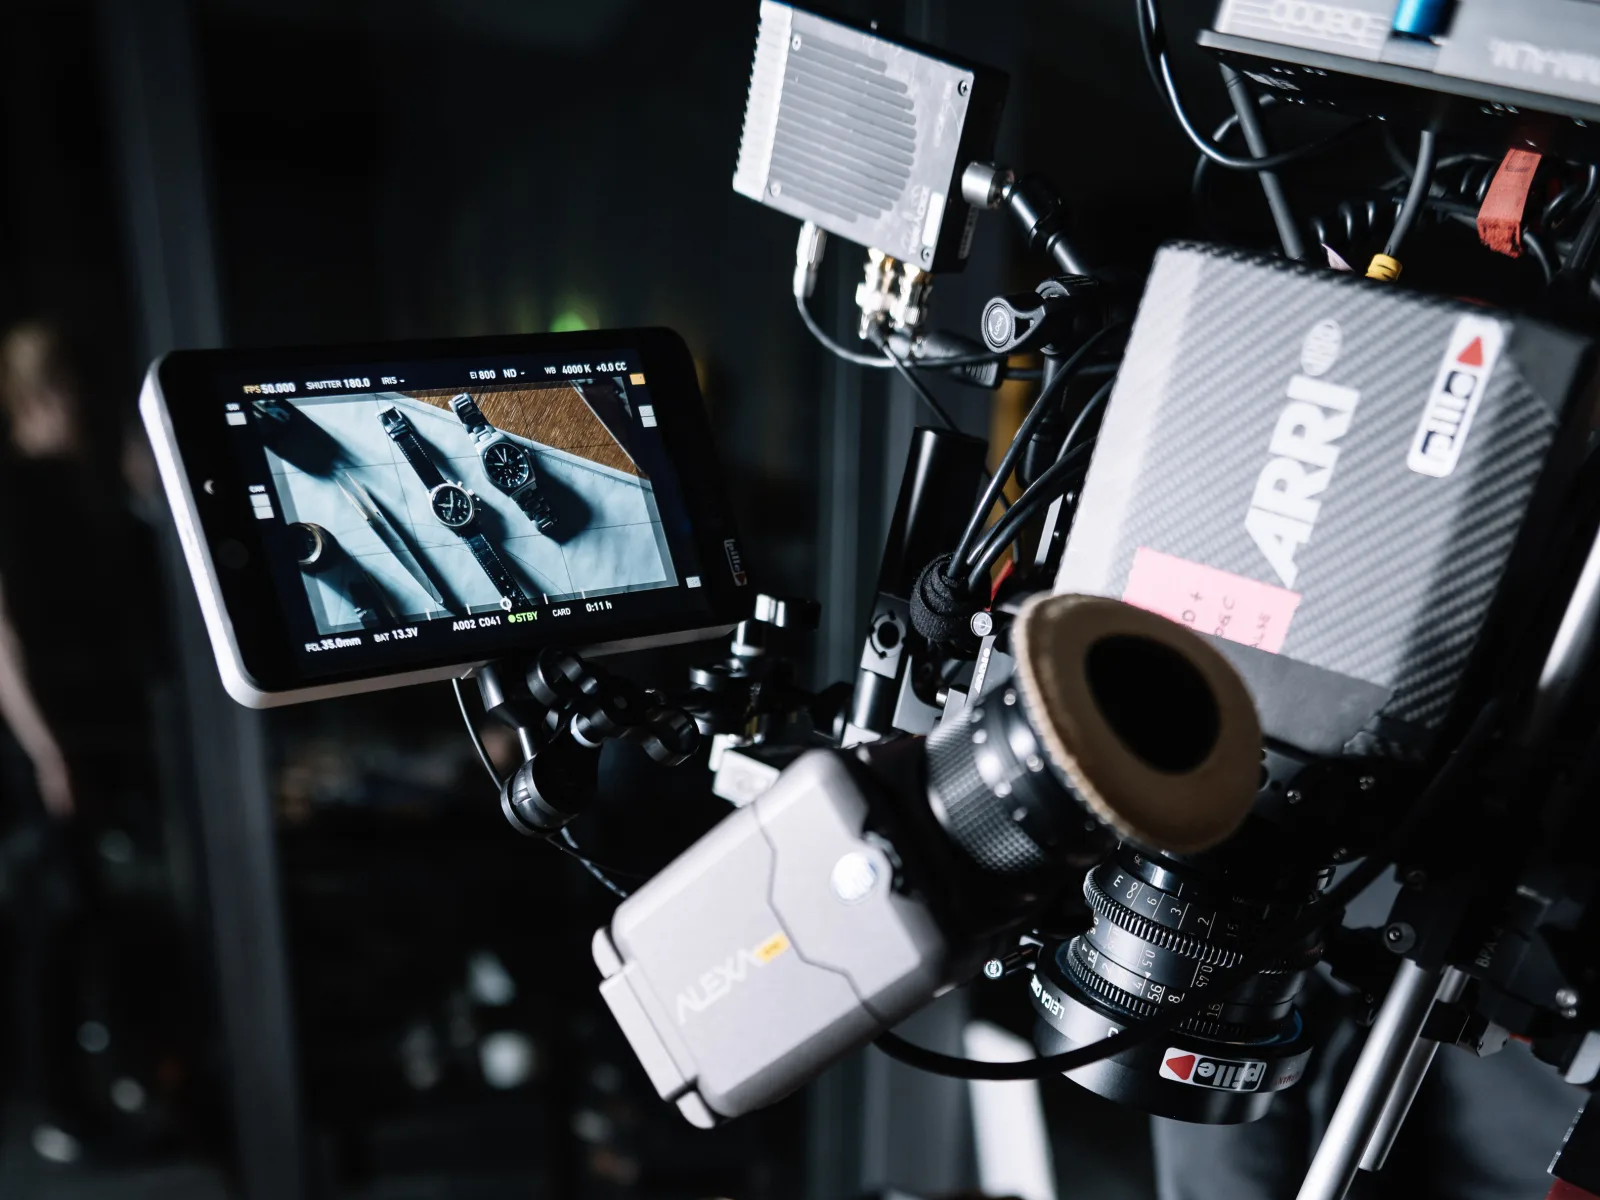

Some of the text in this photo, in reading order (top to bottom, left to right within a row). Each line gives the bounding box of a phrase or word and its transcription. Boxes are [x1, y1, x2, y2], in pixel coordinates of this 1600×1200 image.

[994, 316, 1004, 336] LOCK
[478, 370, 496, 380] 800
[503, 368, 517, 378] ND
[544, 366, 557, 375] WB
[562, 364, 584, 375] 4000
[584, 363, 592, 374] K
[614, 362, 627, 371] CC
[243, 385, 261, 394] FPS
[261, 382, 296, 394] 50.000
[305, 380, 342, 390] SHUTTER
[343, 378, 371, 389] 180.0
[381, 376, 397, 385] IRIS
[1245, 374, 1360, 590] ARRI
[452, 619, 477, 632] A002
[478, 616, 501, 628] C041
[515, 610, 538, 623] STBY
[552, 607, 571, 617] CARD
[585, 602, 604, 613] 0:11
[373, 632, 390, 642] BAT
[391, 627, 418, 641] 13.3V
[1197, 917, 1210, 926] 2
[1041, 990, 1065, 1019] LEICA
[1168, 994, 1180, 1004] 8
[1197, 1061, 1265, 1091] pille
